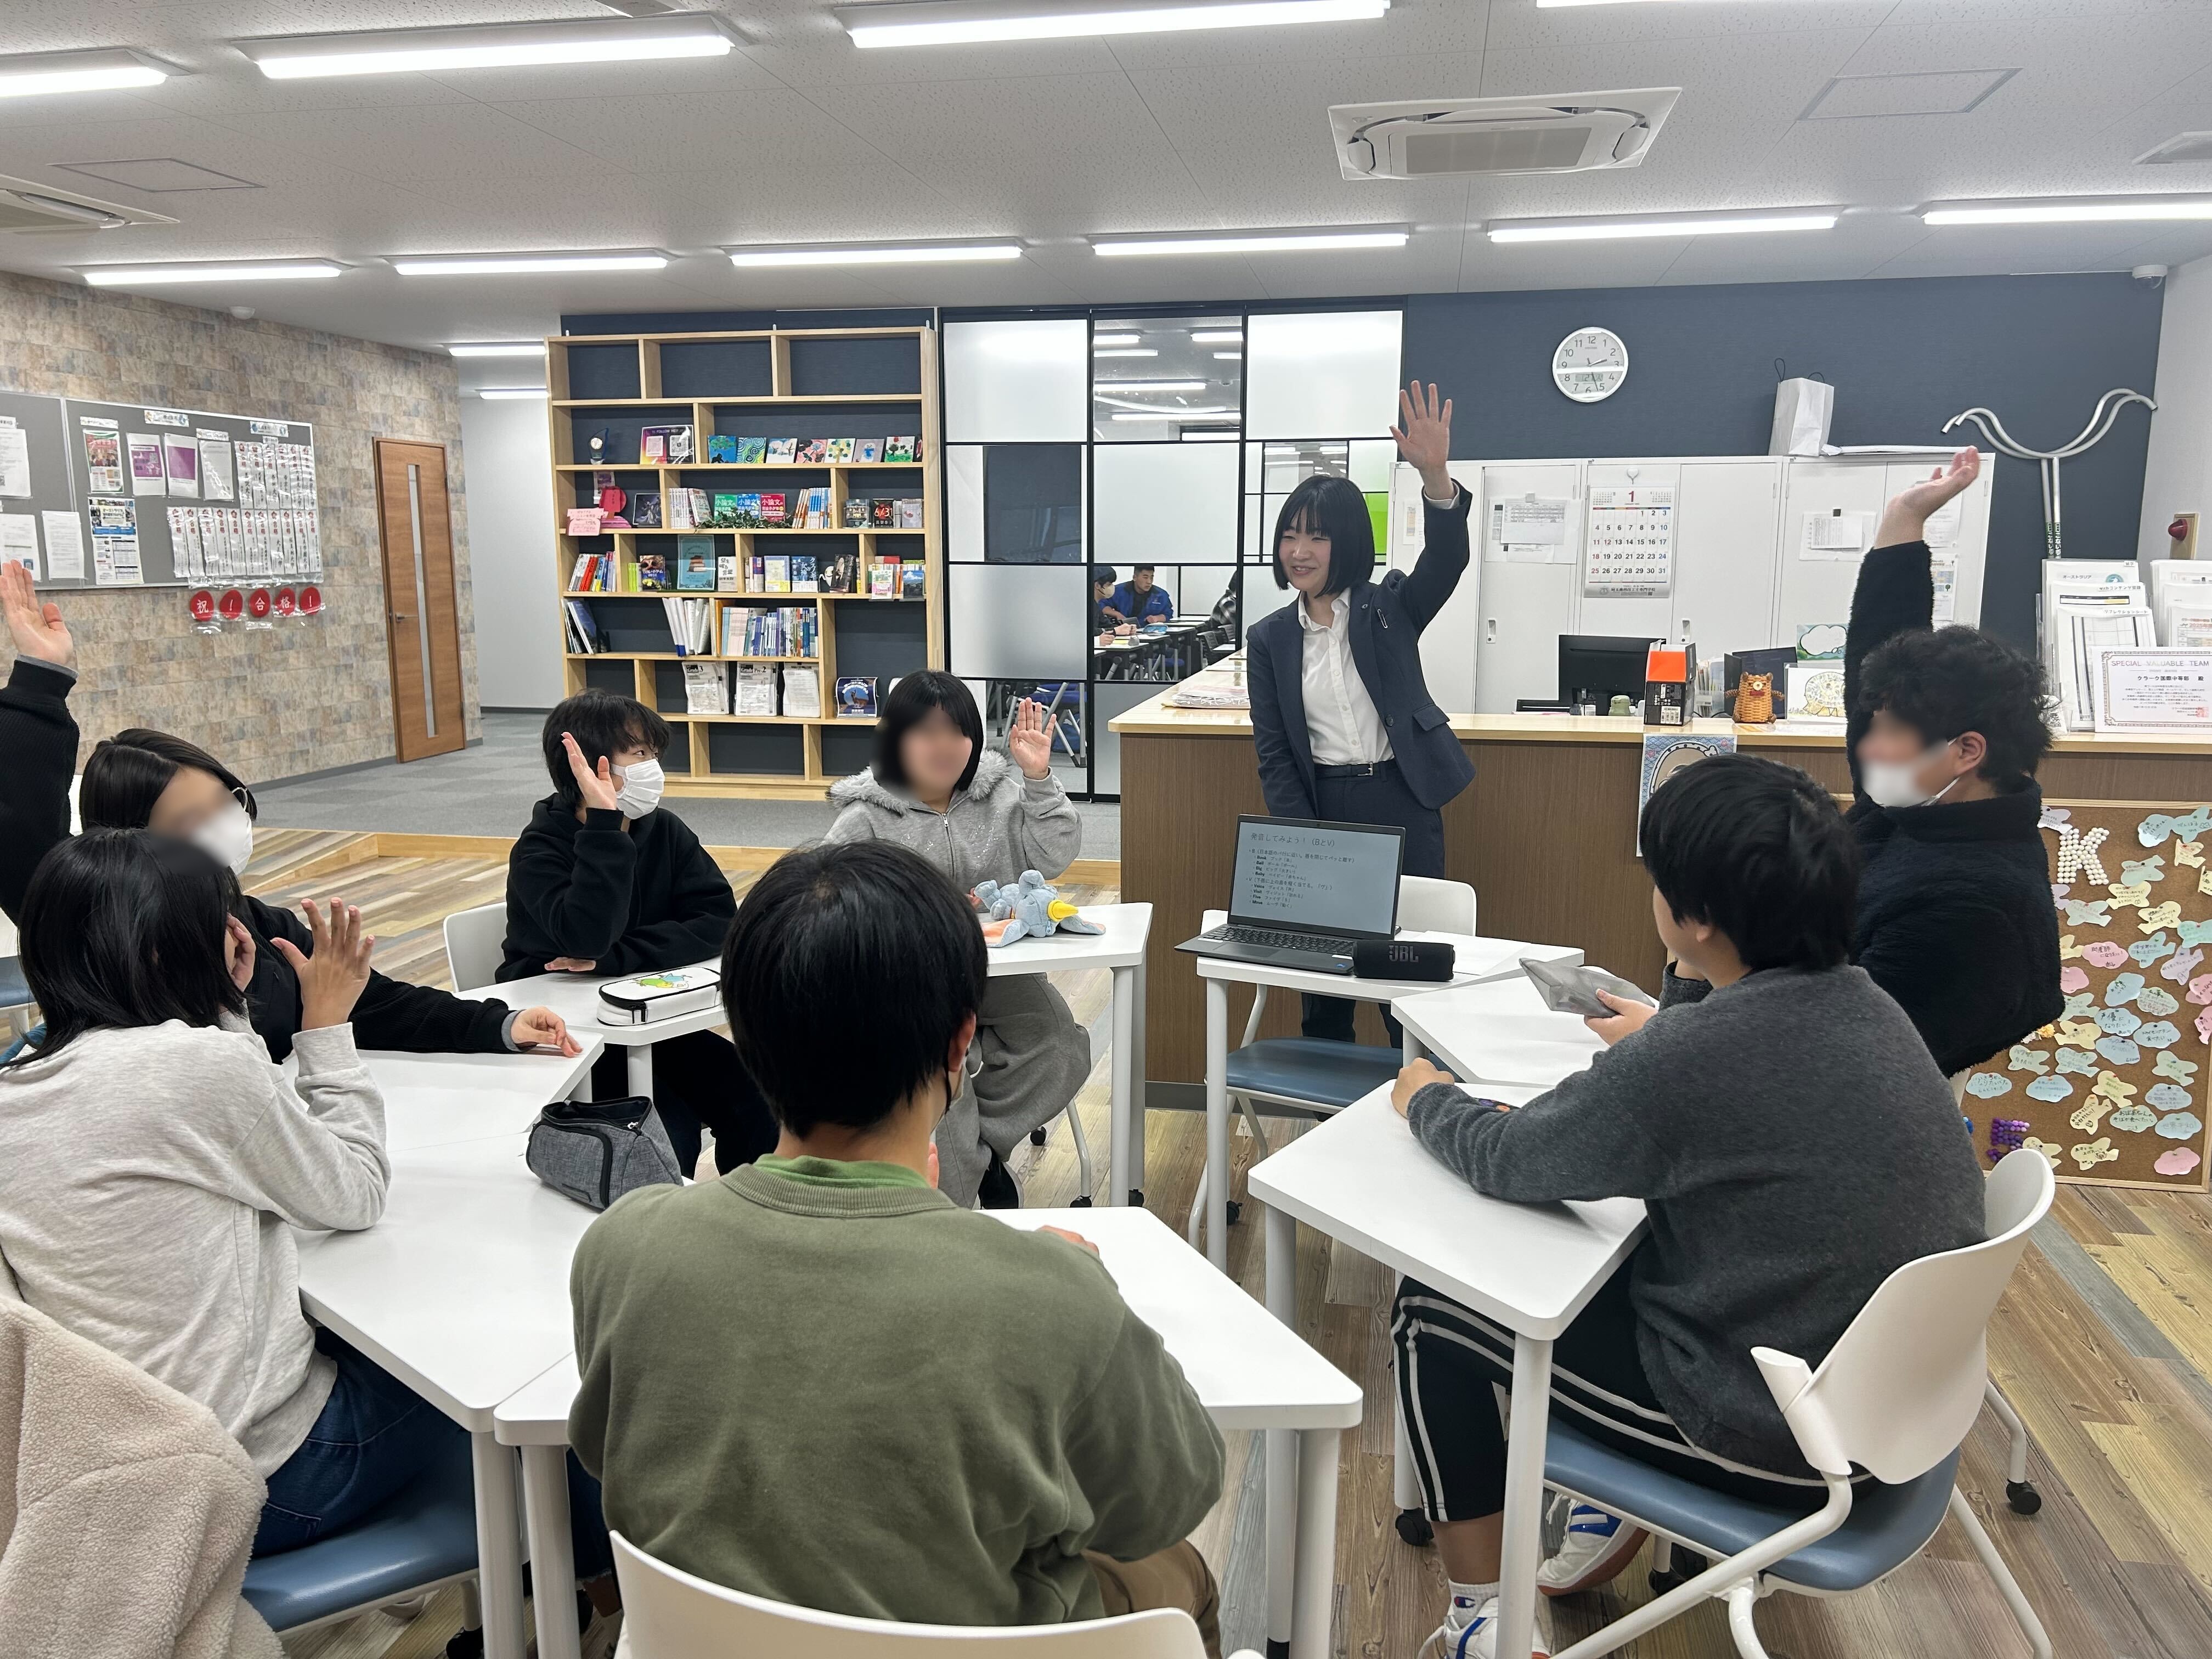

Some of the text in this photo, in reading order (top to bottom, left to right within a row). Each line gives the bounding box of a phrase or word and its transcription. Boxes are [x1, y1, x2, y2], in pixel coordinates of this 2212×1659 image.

[1588, 336, 1596, 344] 12
[1628, 491, 1634, 502] 1
[2057, 827, 2110, 886] K
[1389, 945, 1419, 963] JBL
